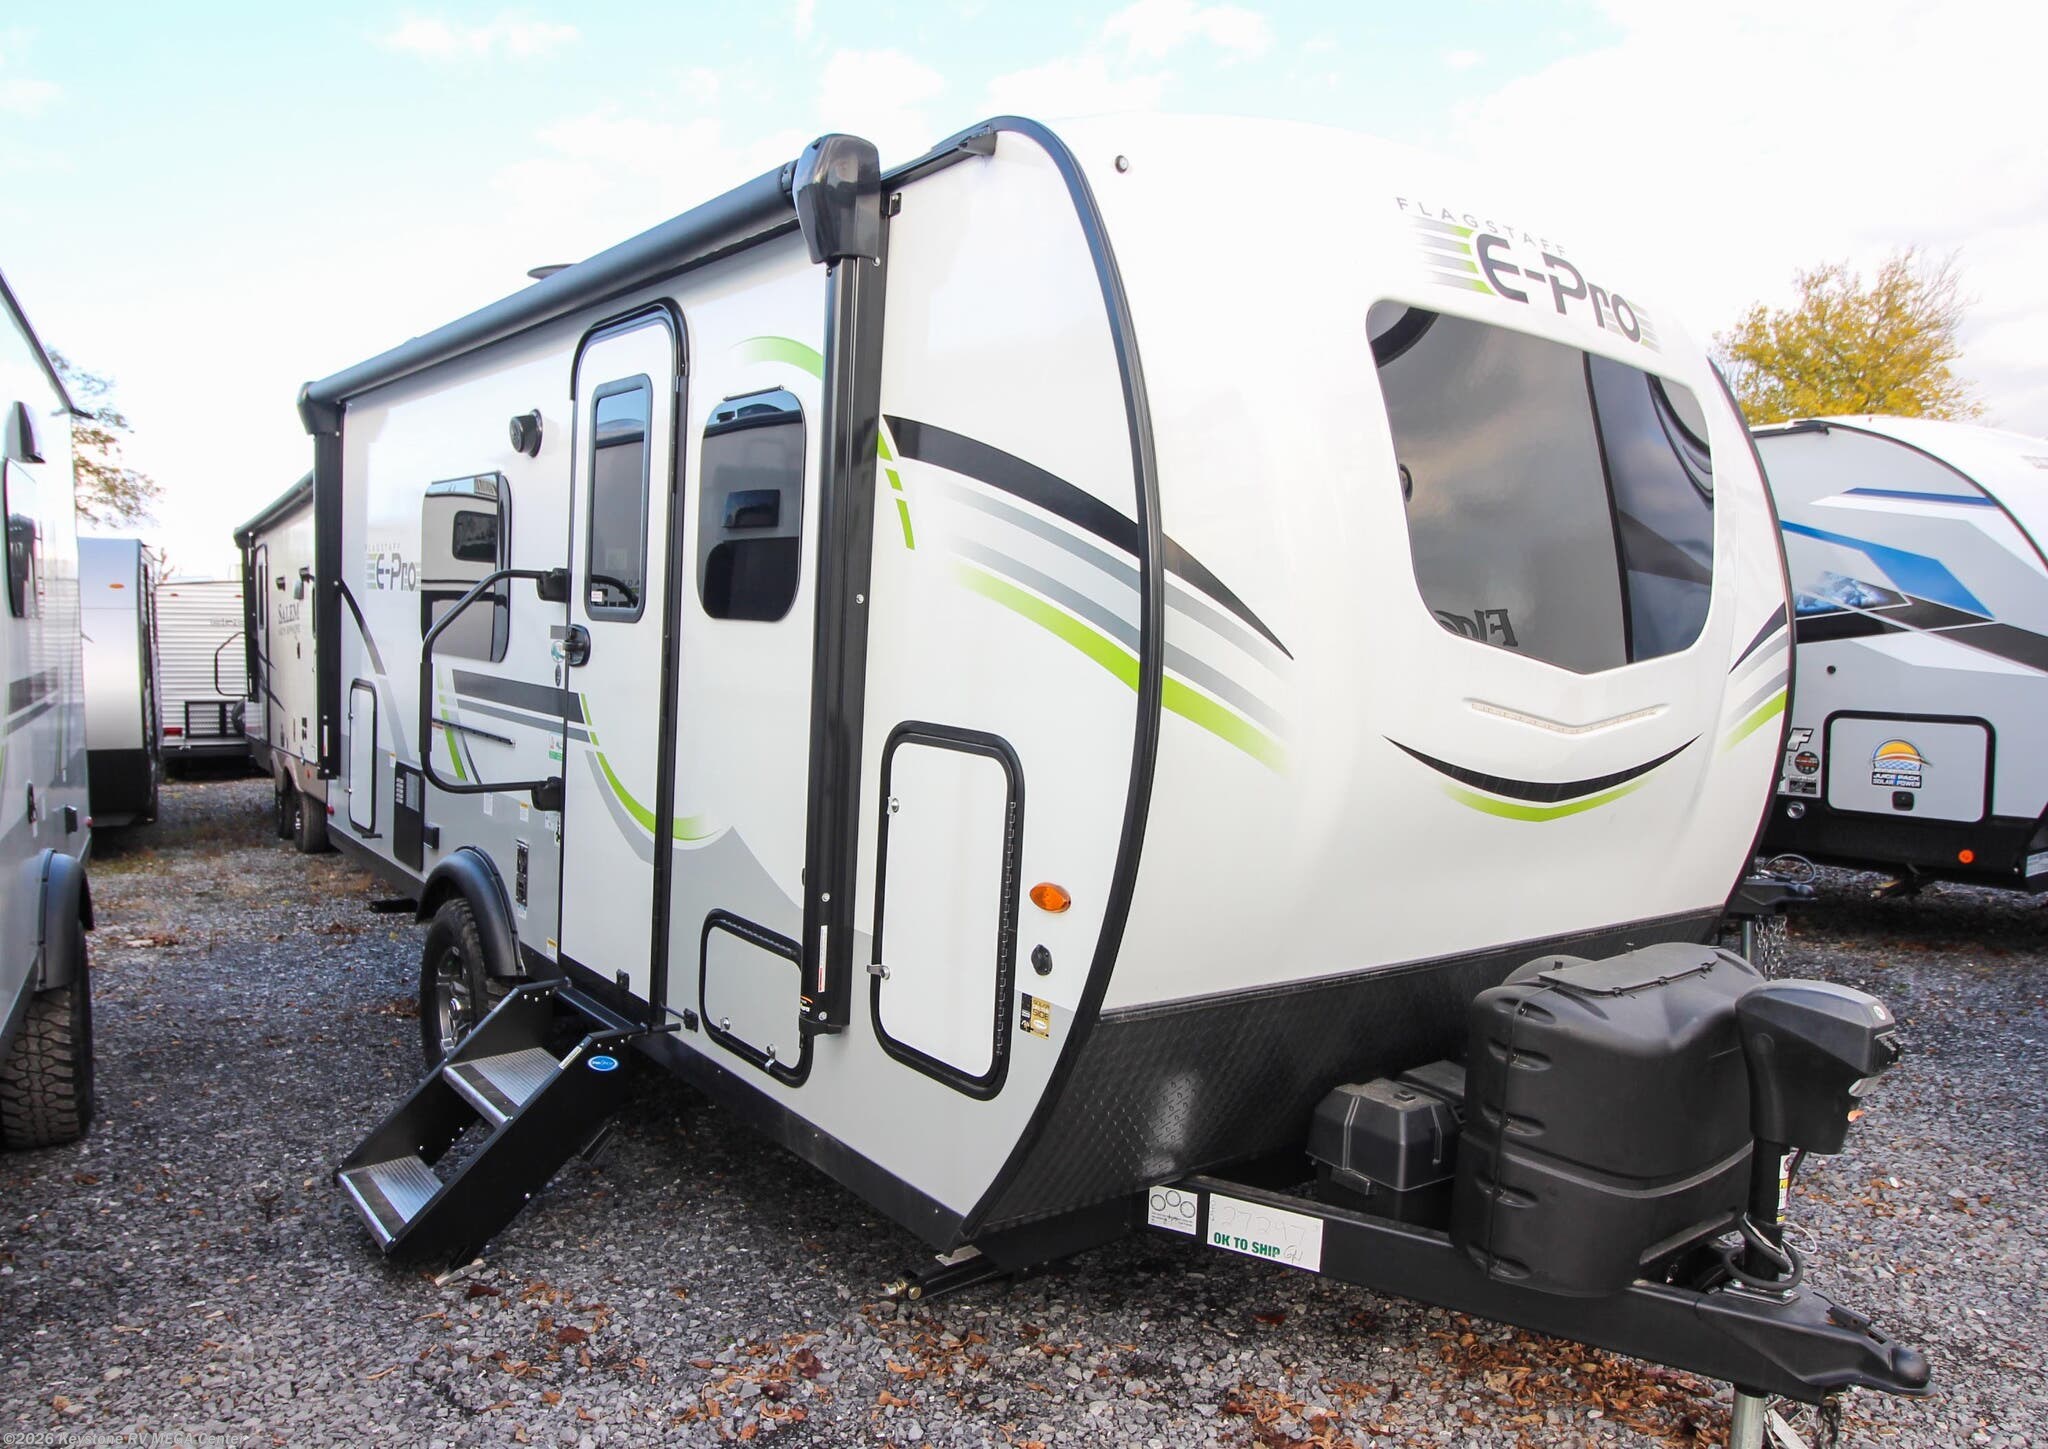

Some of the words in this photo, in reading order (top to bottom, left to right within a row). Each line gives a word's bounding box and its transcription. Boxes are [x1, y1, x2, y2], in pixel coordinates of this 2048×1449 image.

[1395, 196, 1567, 257] FLAGSTAFF
[1476, 232, 1641, 343] E-Pro
[376, 552, 417, 592] E-Pro
[1213, 1231, 1231, 1247] OK
[1233, 1236, 1248, 1251] TO
[1251, 1241, 1281, 1258] SHIP
